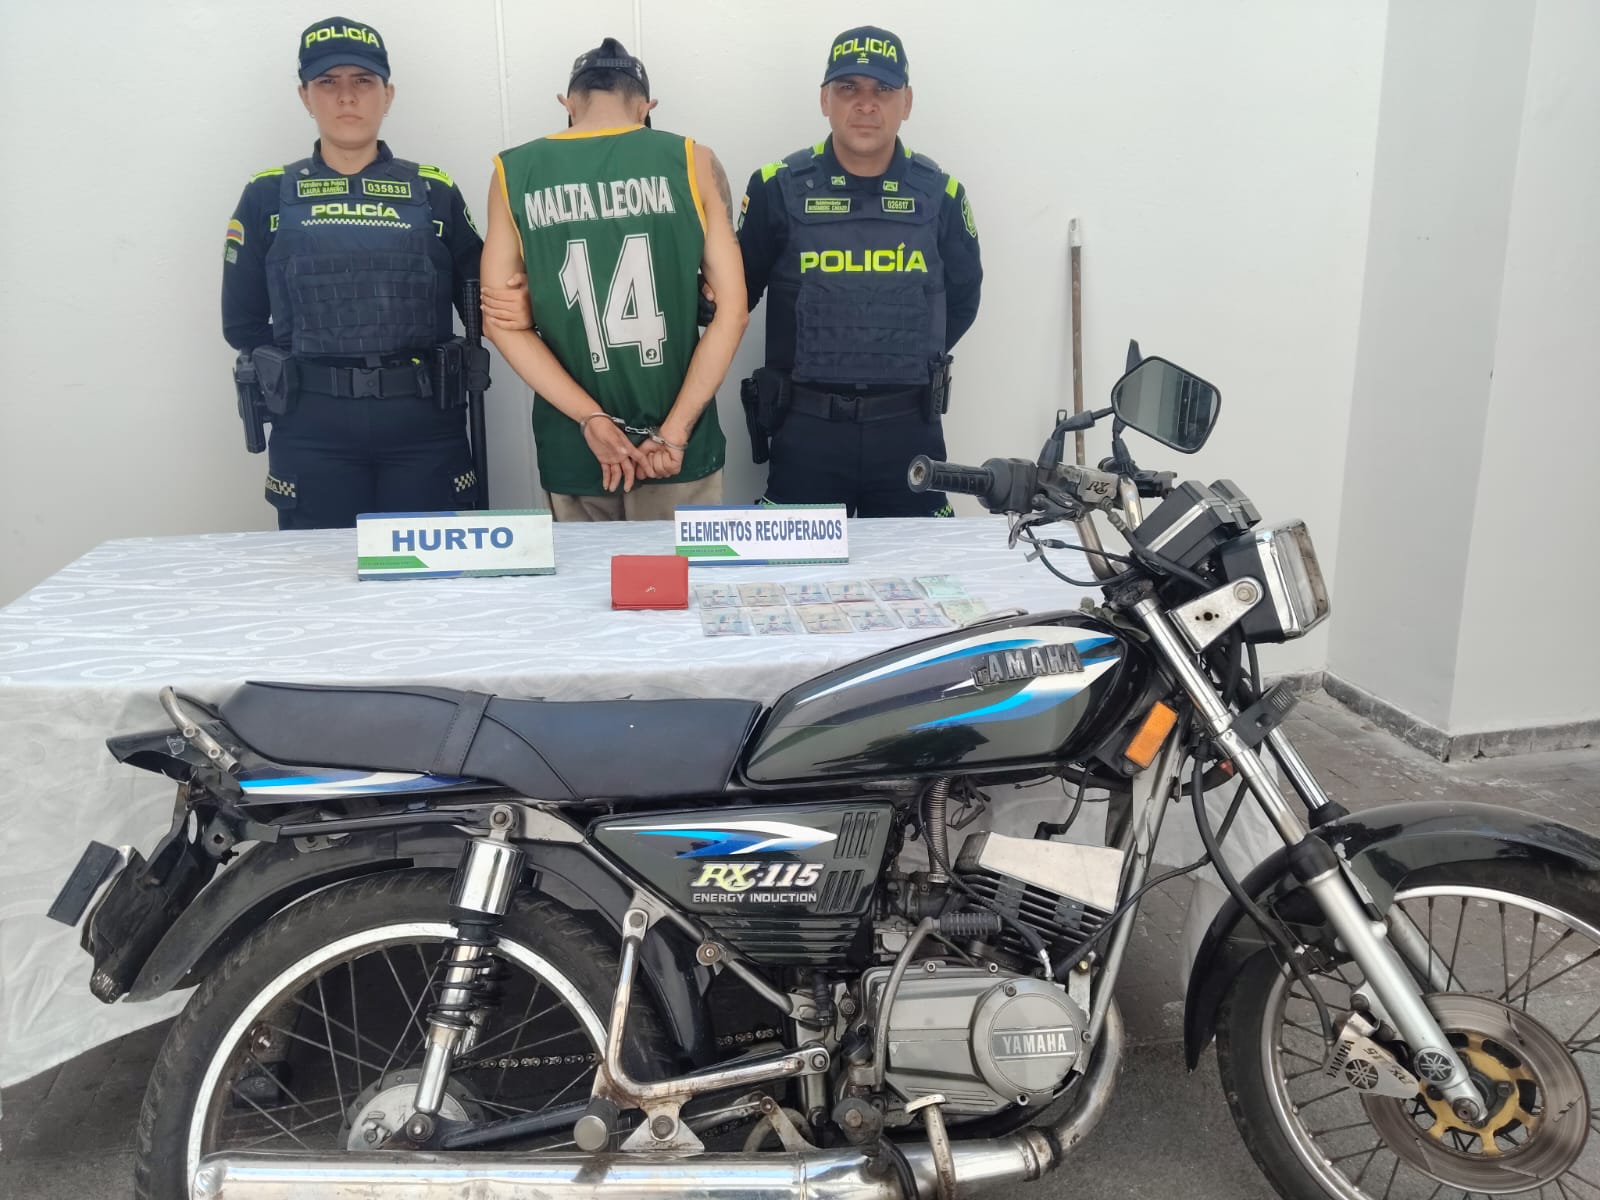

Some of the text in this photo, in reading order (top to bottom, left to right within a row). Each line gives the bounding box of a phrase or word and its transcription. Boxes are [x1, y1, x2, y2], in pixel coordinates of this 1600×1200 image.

[305, 25, 380, 48] POLICÍA
[832, 37, 898, 62] POLICÍA
[367, 183, 407, 194] 035838
[311, 202, 400, 219] POLICÍA
[524, 176, 676, 230] MALTA LEONA
[800, 242, 928, 273] POLICÍA
[558, 233, 667, 372] 14
[392, 526, 514, 552] HURTO
[680, 519, 842, 542] ELEMENTOS RECUPERADOS
[693, 892, 817, 903] ENERGY INDUCTION
[1002, 1032, 1067, 1055] YAMAHA
[1326, 1039, 1355, 1078] YAMAHA
